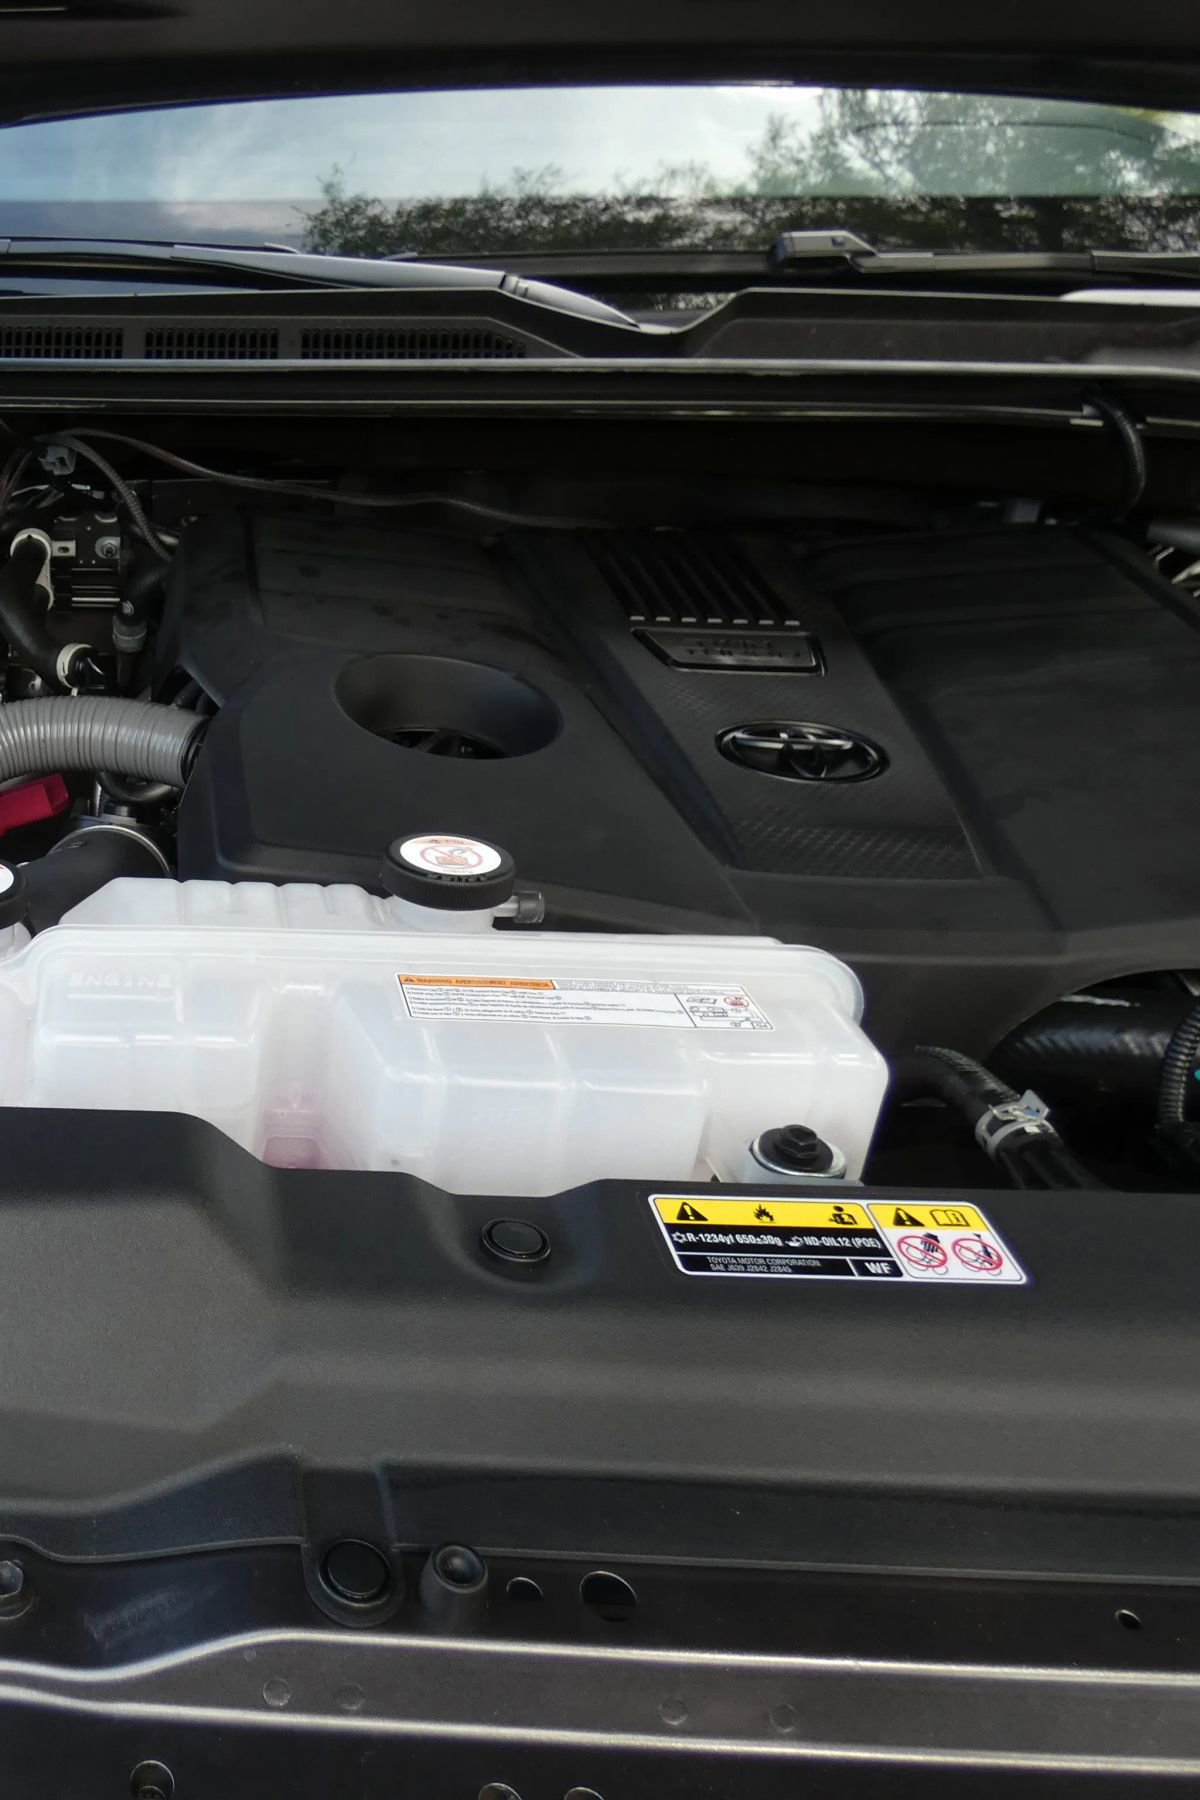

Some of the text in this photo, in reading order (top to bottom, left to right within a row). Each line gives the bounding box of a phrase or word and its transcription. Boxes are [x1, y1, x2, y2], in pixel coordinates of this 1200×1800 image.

[68, 971, 174, 989] ENGINE
[686, 1232, 735, 1245] R-1234yf
[851, 1236, 882, 1249] (POE)
[706, 1256, 822, 1267] TOYOTA MOTOR CORPORATION
[709, 1263, 727, 1271] SAE
[864, 1261, 893, 1275] WF
